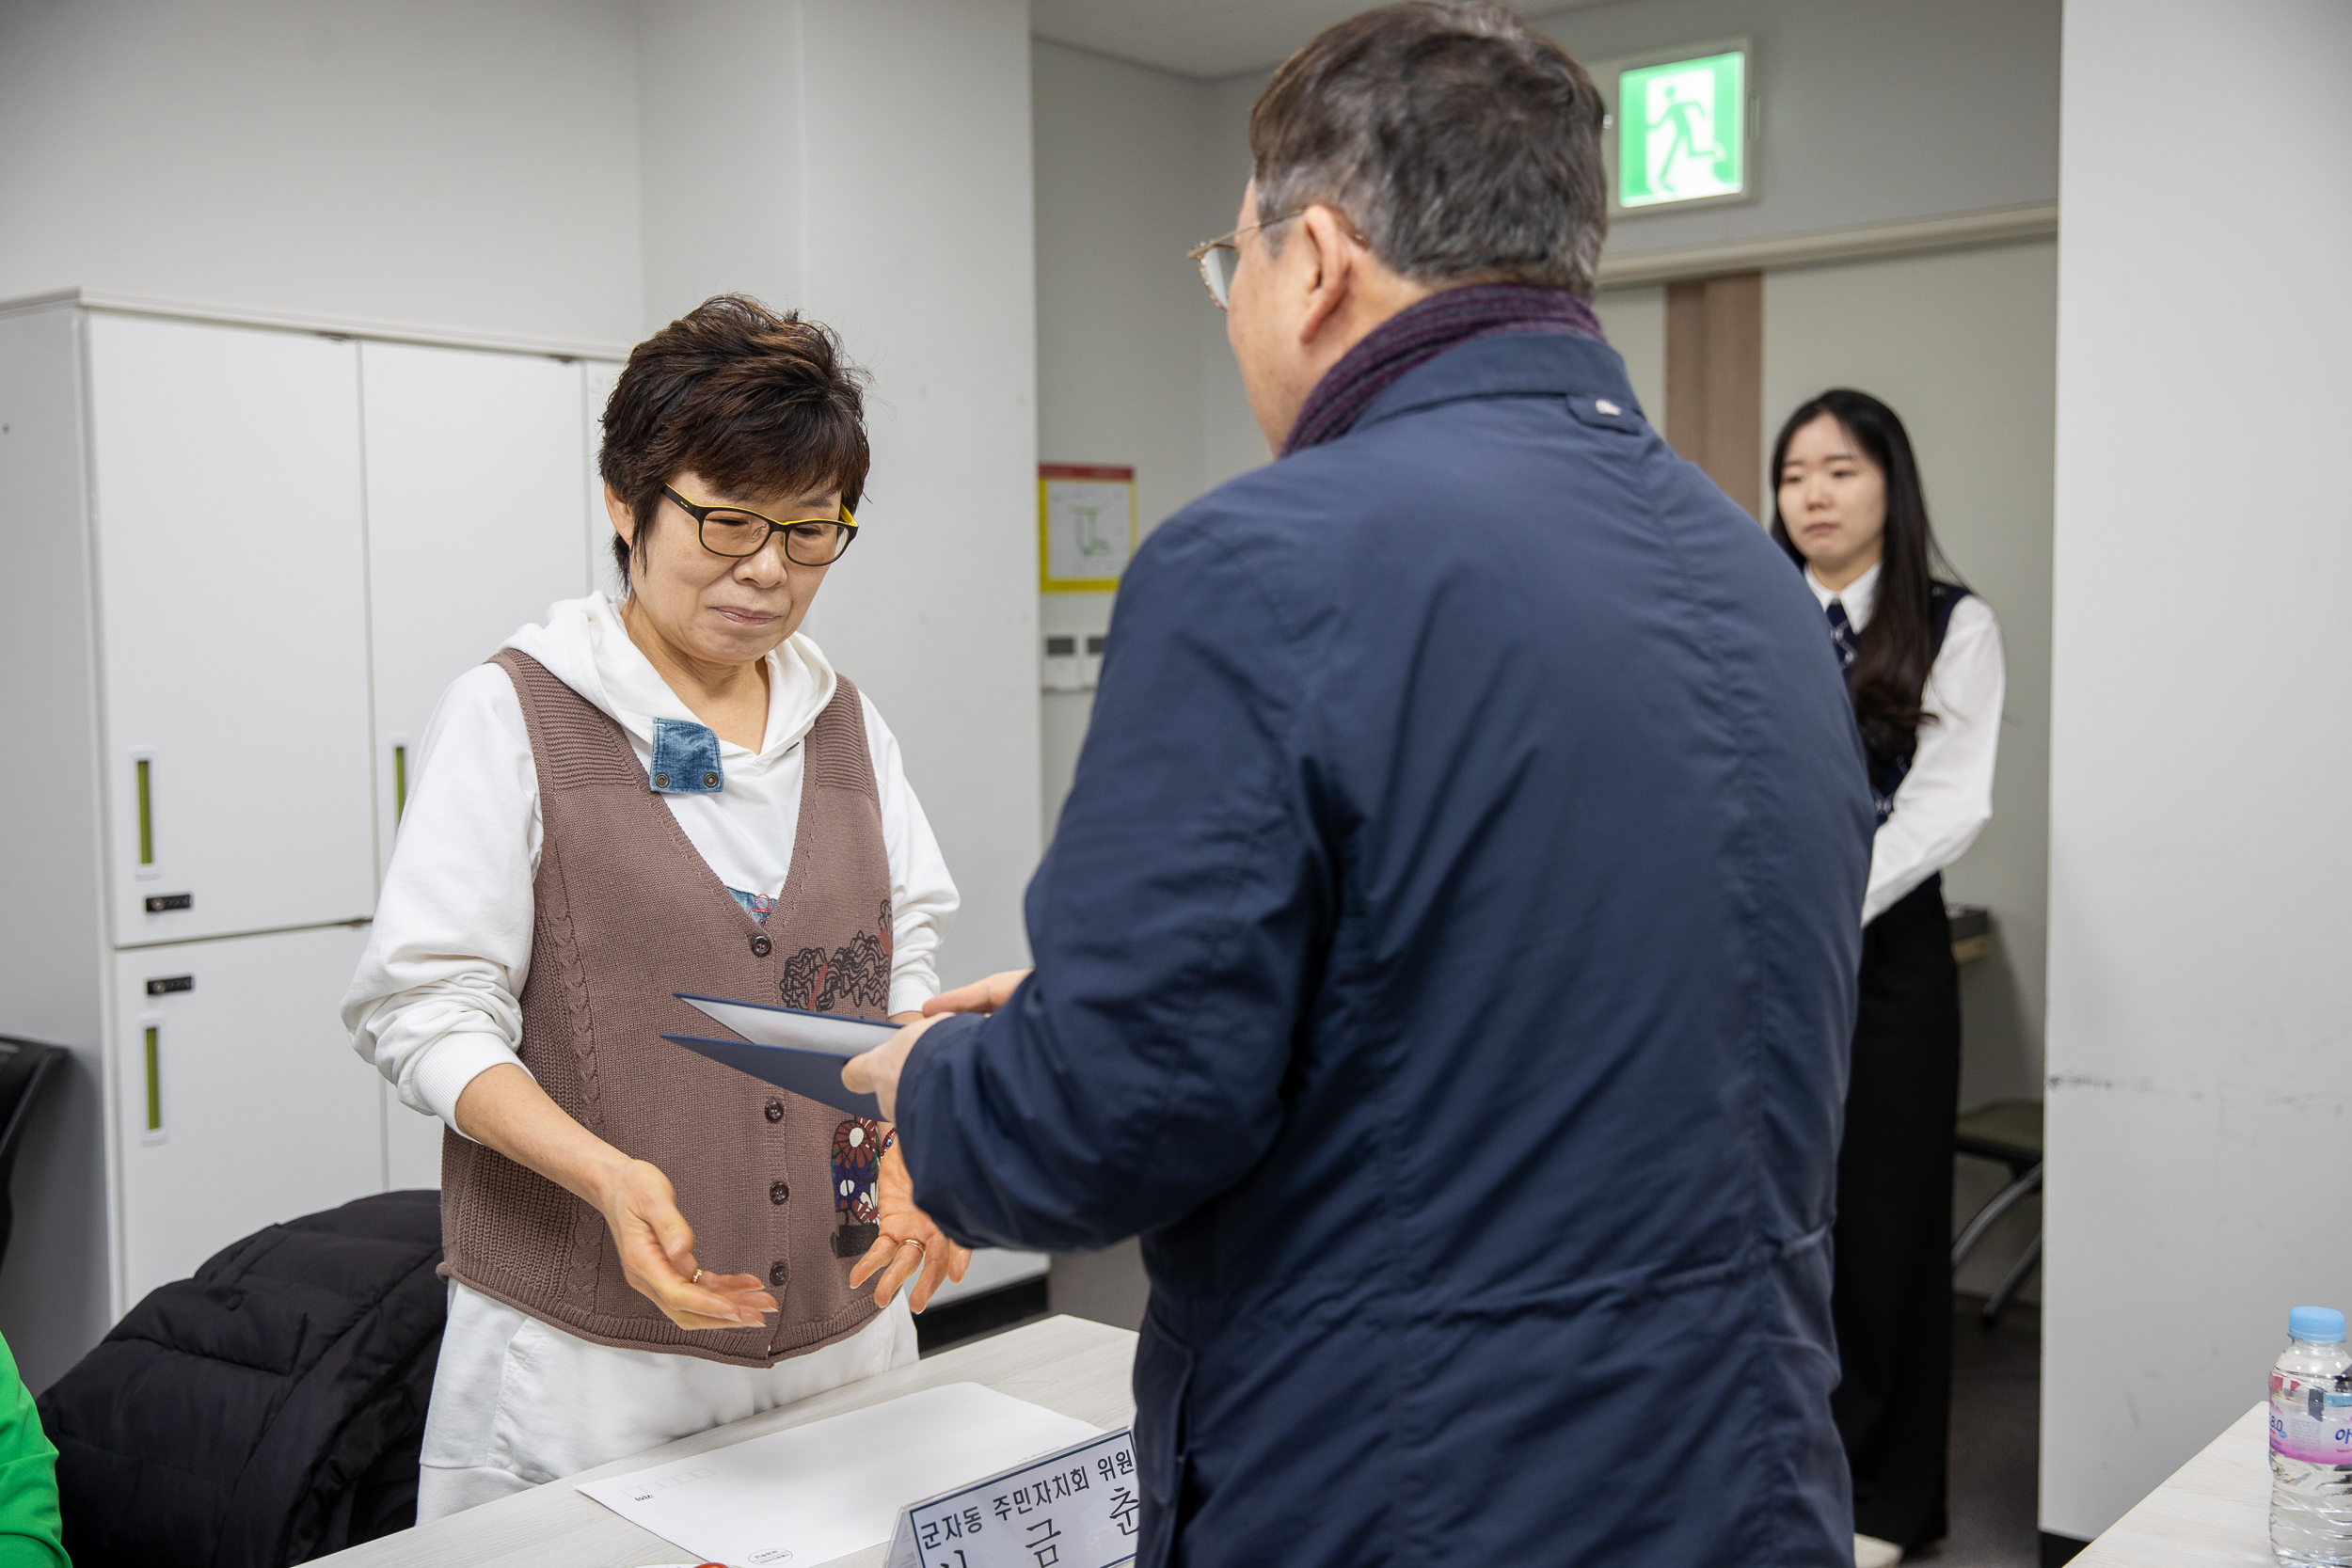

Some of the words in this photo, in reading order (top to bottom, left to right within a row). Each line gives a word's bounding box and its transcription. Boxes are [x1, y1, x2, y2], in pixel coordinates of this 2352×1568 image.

[2334, 1428, 2352, 1445] 아
[919, 1505, 983, 1551] 군자동
[993, 1465, 1090, 1522] 주민자치회
[1096, 1449, 1136, 1482] 위원
[1024, 1517, 1062, 1568] 금
